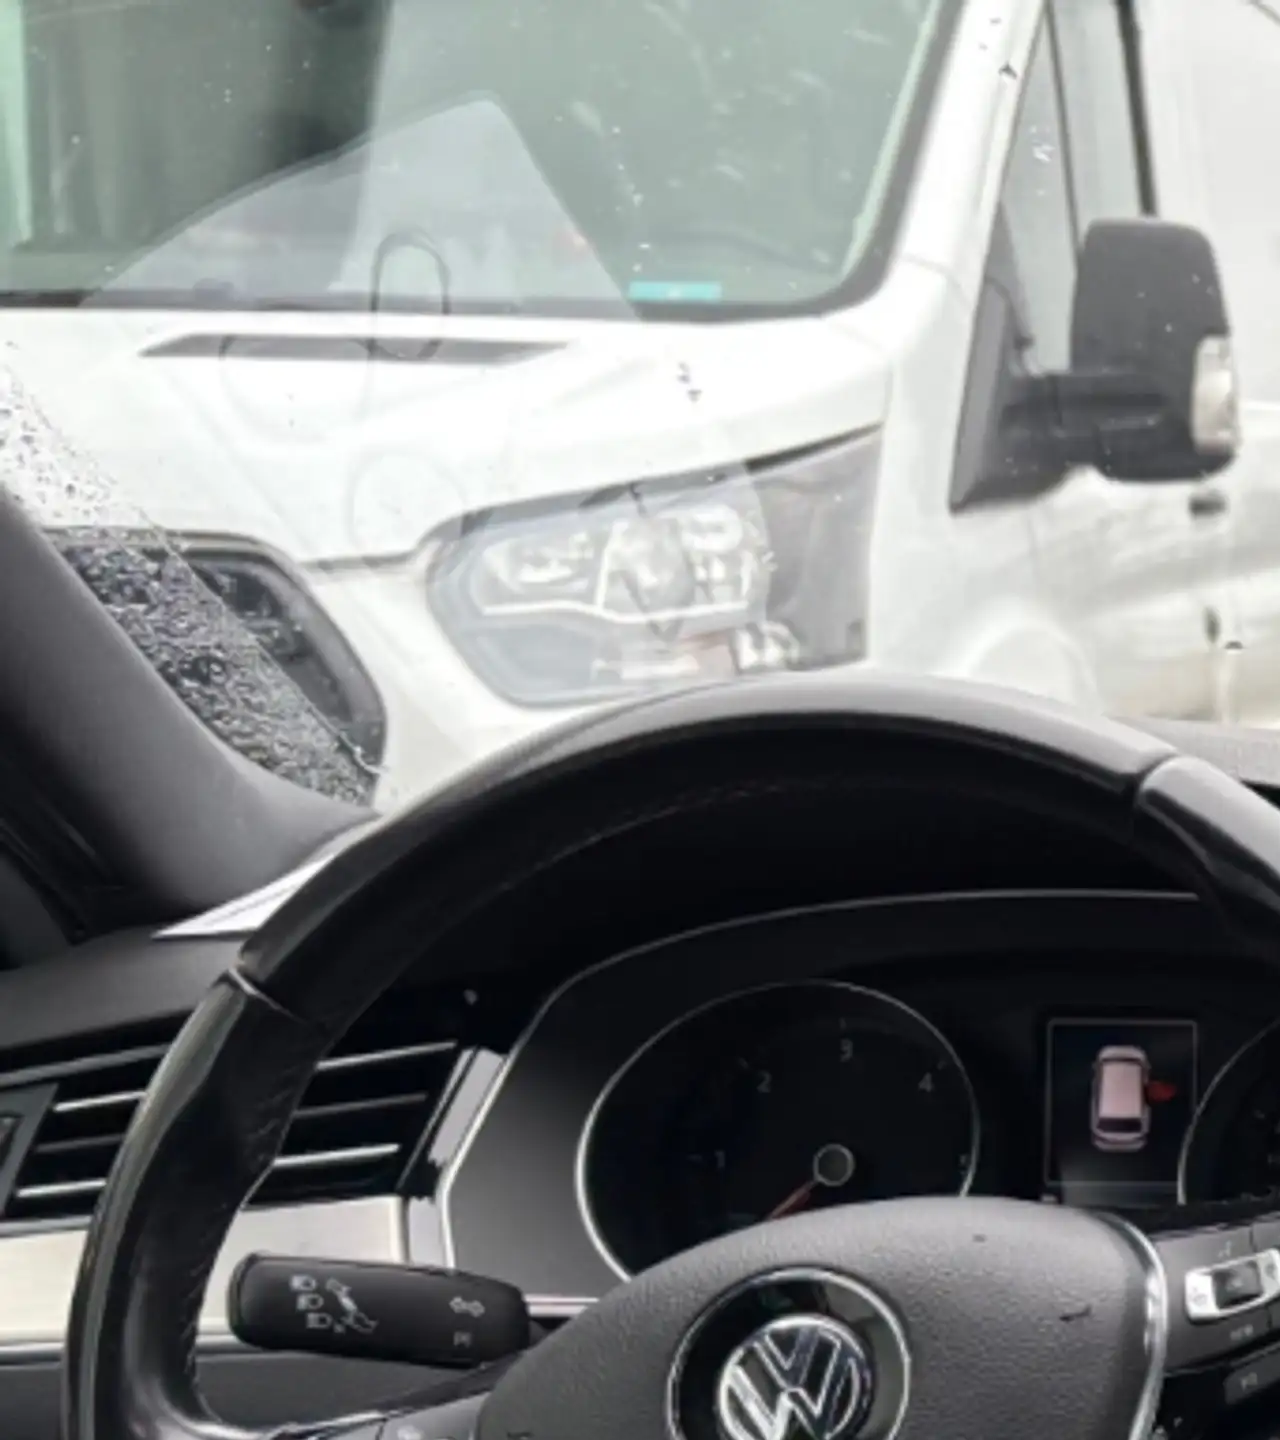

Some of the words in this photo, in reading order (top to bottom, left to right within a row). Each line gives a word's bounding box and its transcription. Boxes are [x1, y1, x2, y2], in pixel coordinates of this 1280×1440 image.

[840, 1038, 855, 1063] 3
[758, 1070, 774, 1094] 2
[919, 1071, 936, 1093] 4
[715, 1149, 728, 1169] 1
